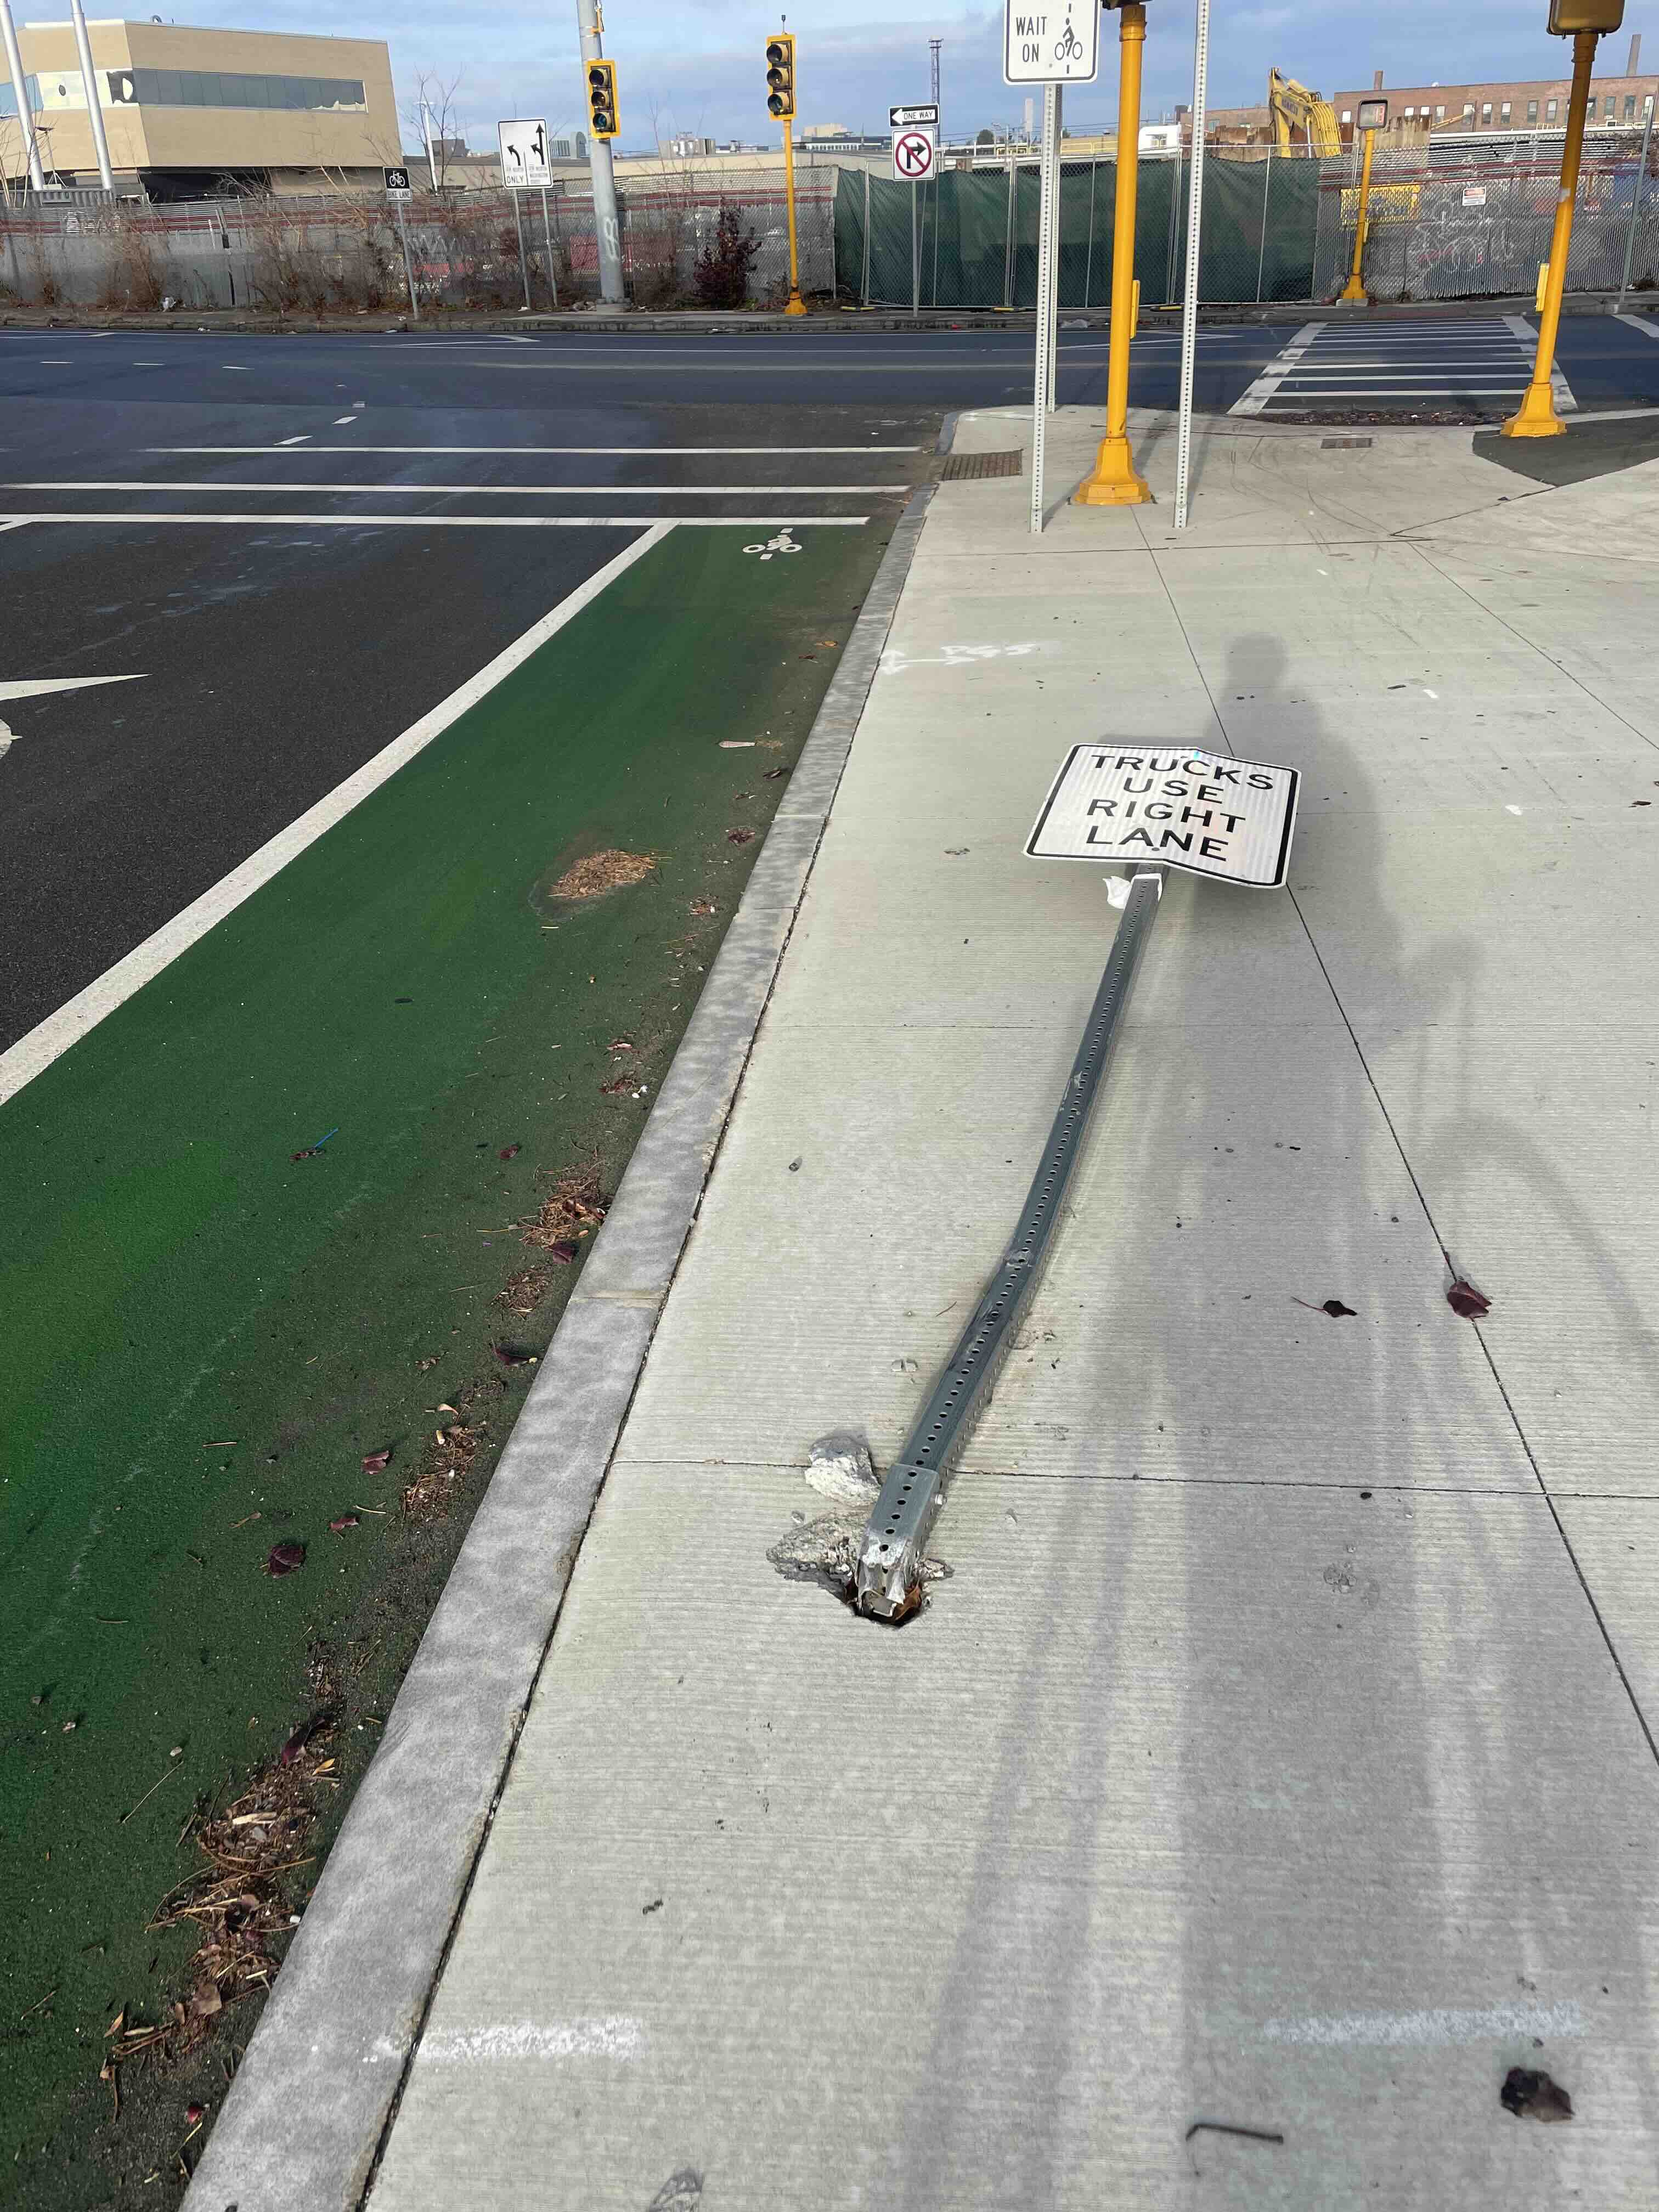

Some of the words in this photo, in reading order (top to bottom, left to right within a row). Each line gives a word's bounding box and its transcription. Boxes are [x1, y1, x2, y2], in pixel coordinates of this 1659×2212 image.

[1016, 16, 1047, 36] WAIT
[1023, 43, 1039, 63] ON
[904, 111, 917, 120] ONE
[919, 110, 933, 119] WAY
[506, 176, 523, 184] ONLY
[1091, 754, 1274, 791] TRUCKS
[1123, 777, 1224, 804] USE
[1086, 799, 1246, 833] RIGHT
[1085, 825, 1229, 862] LANE
